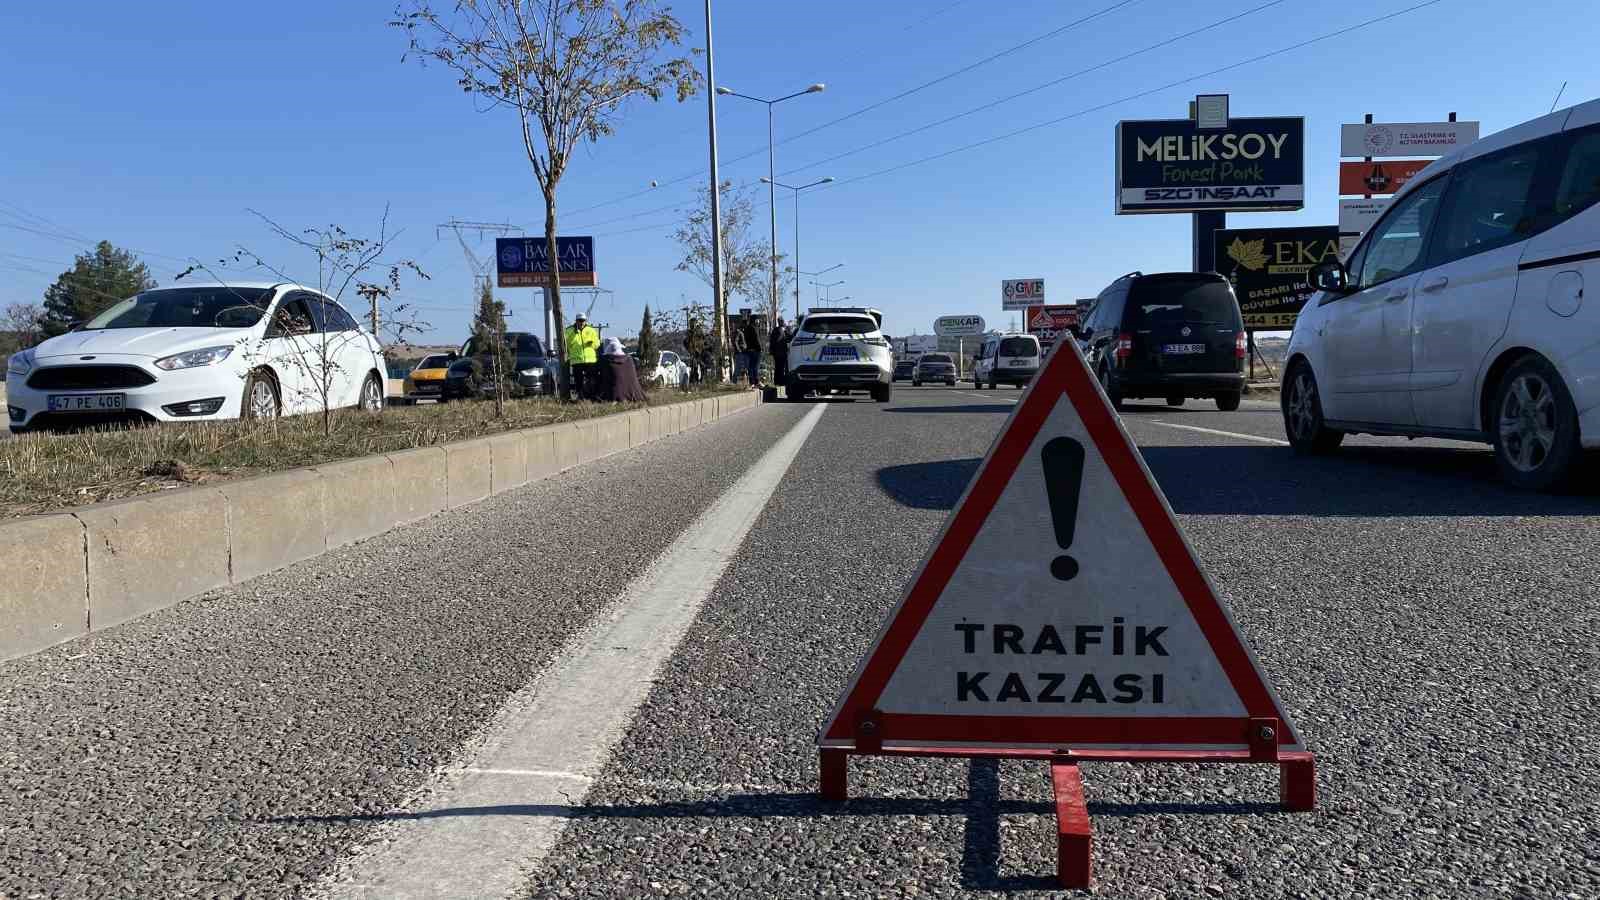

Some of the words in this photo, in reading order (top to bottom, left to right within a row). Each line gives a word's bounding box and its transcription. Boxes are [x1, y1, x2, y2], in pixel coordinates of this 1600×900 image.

[1162, 162, 1215, 184] Forest
[1220, 161, 1264, 183] Park
[524, 257, 590, 273] HASANESİ
[56, 397, 69, 409] 47
[78, 397, 91, 409] PE
[99, 396, 120, 408] 406
[955, 616, 1169, 657] TRAFİK
[957, 671, 1164, 704] KAZASI
